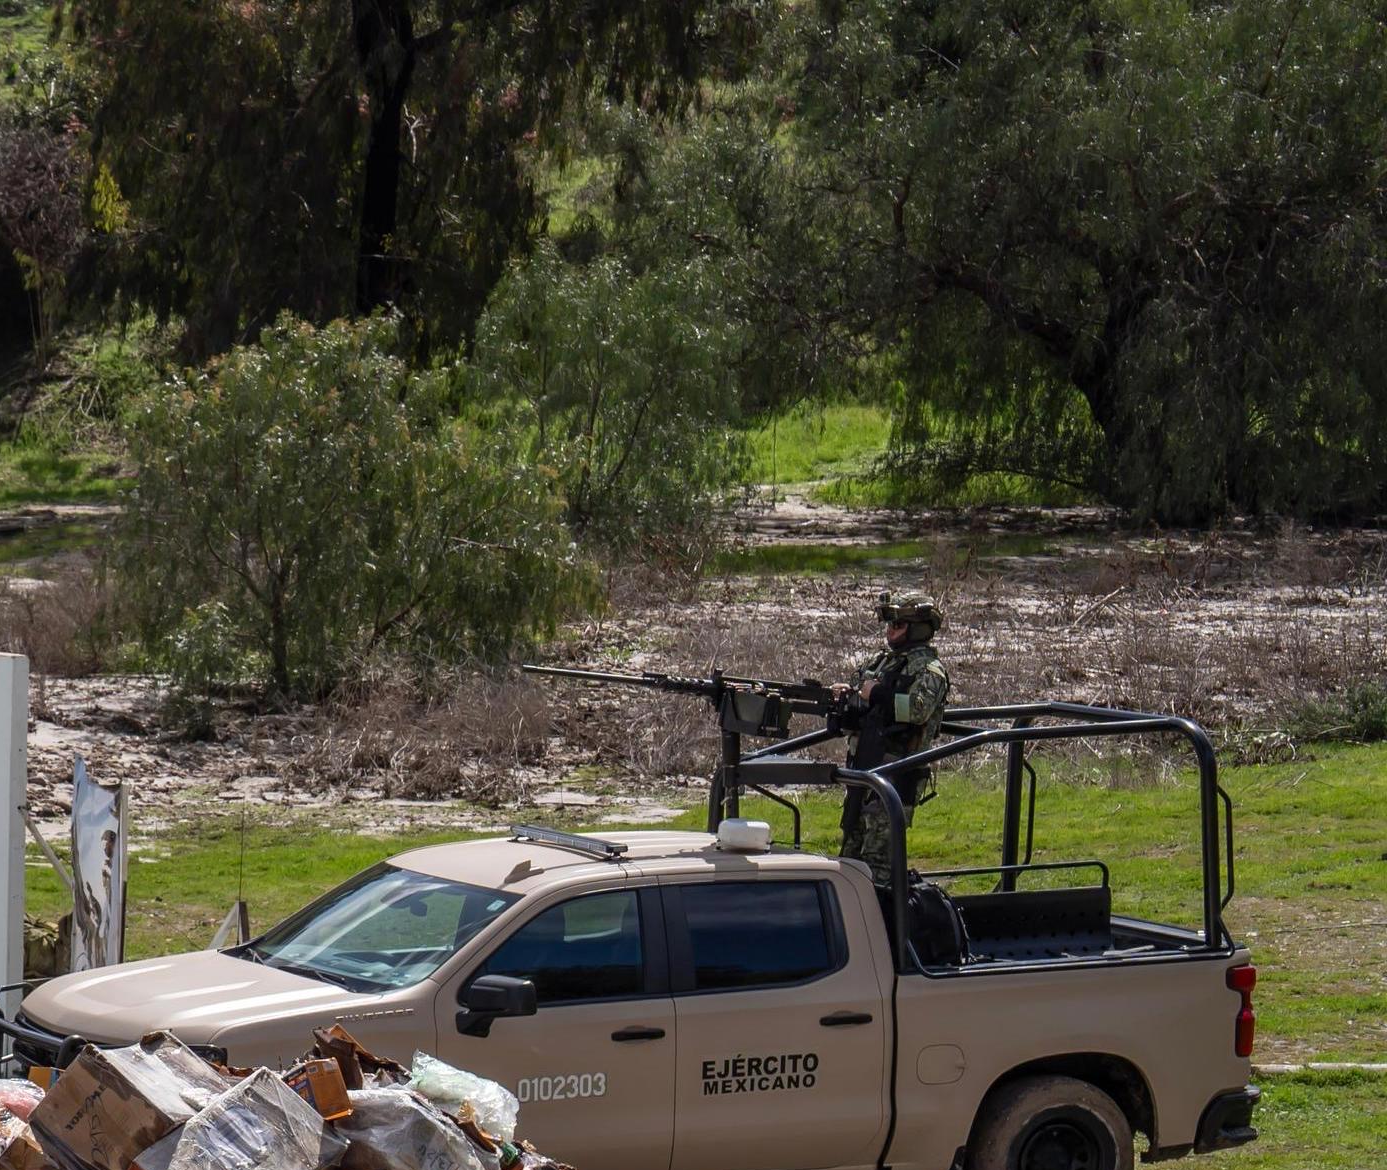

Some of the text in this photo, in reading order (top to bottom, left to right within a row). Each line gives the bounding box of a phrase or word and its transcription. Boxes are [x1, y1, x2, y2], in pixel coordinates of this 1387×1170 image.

[701, 1053, 819, 1080] EJÉRCITO
[517, 1073, 606, 1103] 0102303
[702, 1073, 816, 1096] MEXICANO
